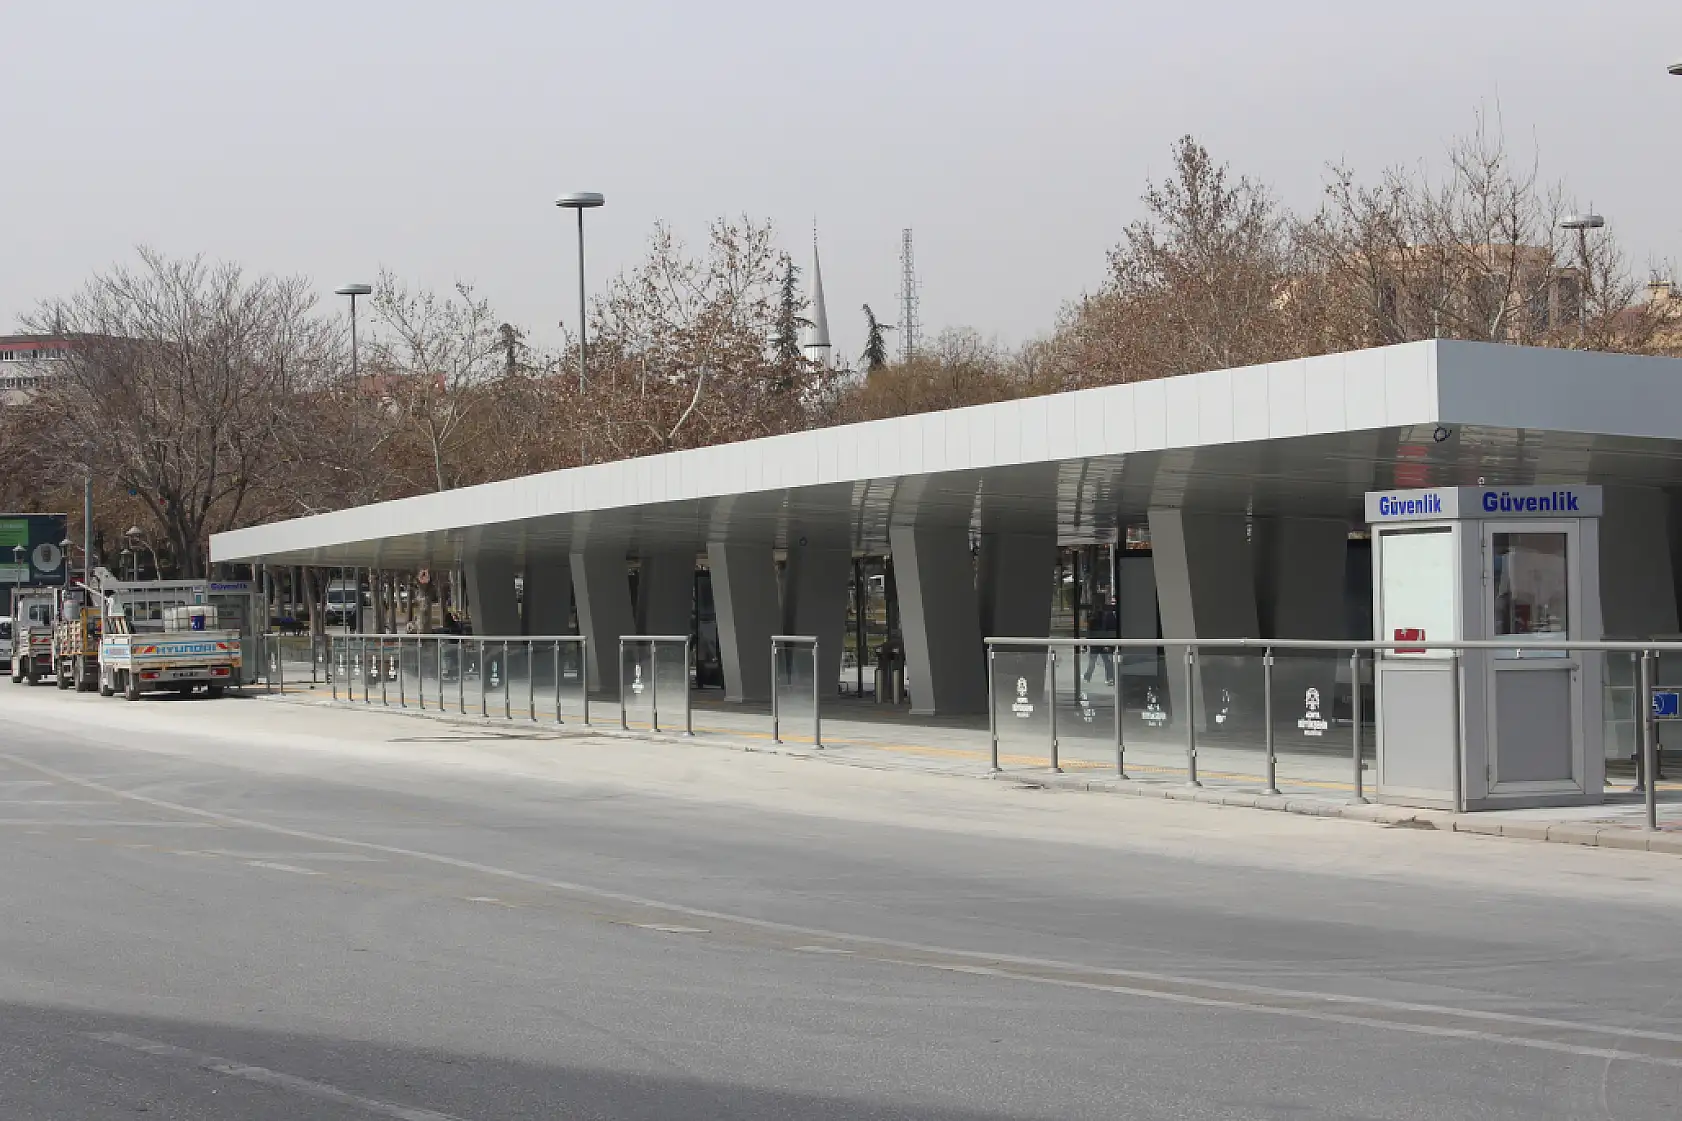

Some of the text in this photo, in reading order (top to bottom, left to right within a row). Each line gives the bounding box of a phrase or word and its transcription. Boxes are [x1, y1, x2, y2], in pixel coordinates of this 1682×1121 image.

[1380, 494, 1441, 515] Güvenlik
[1483, 492, 1579, 512] Güvenlik
[157, 644, 217, 654] HYUNDAI
